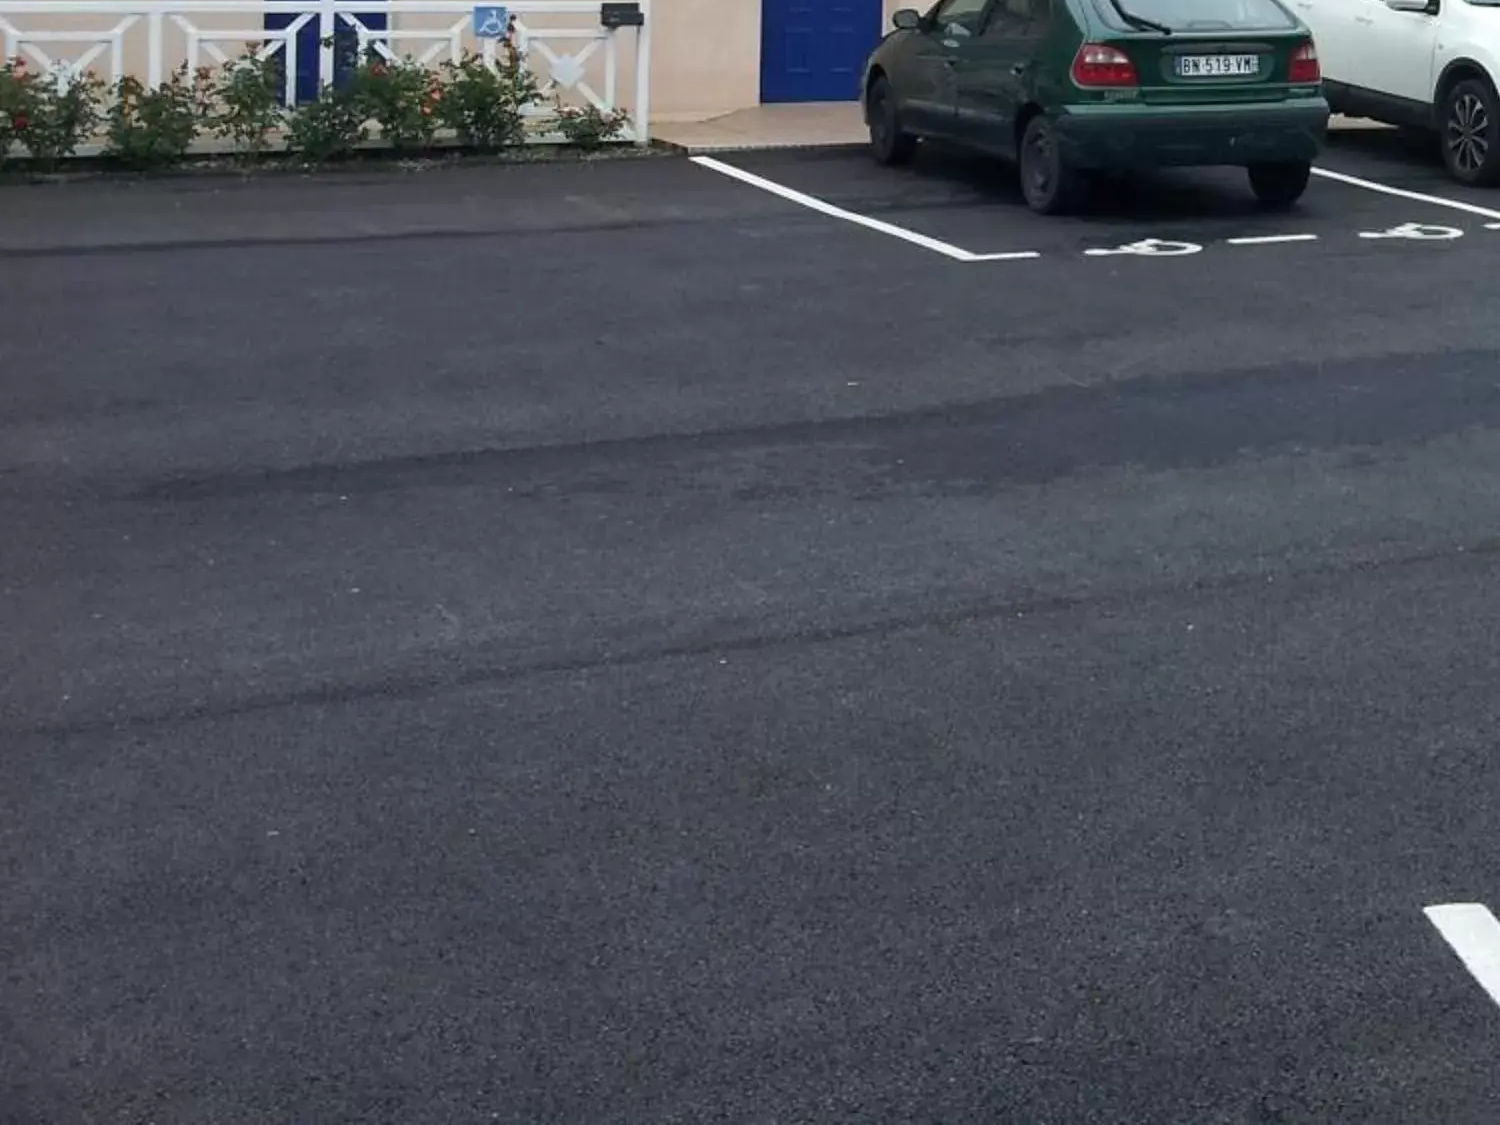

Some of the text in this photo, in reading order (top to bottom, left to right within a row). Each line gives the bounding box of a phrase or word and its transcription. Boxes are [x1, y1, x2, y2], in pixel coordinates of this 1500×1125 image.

[1183, 55, 1251, 74] BN 519 VM
